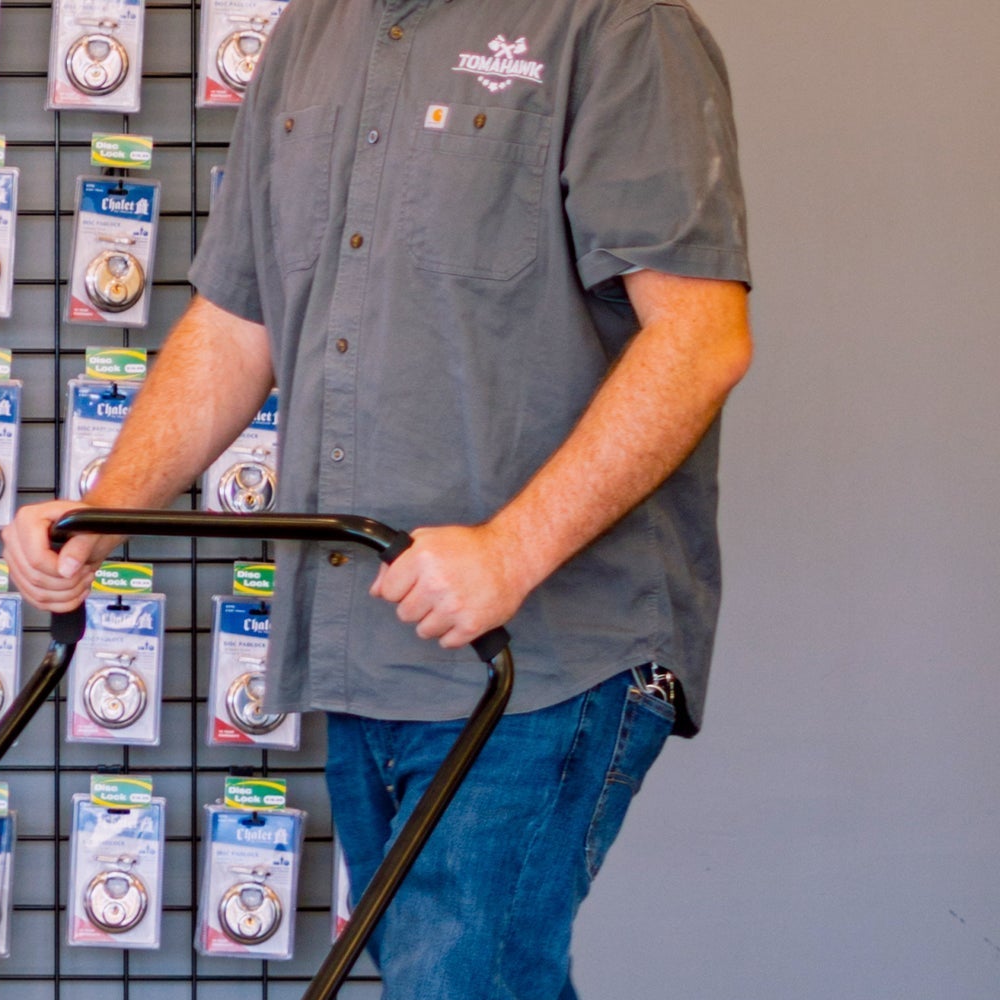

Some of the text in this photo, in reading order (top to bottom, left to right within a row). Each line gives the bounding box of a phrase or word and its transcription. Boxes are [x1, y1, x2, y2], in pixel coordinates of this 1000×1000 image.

[459, 53, 544, 79] TOMAHAWK
[96, 141, 119, 150] Disc
[100, 150, 125, 159] Lock
[101, 197, 134, 212] Chalet
[97, 402, 132, 416] Chale
[237, 571, 261, 579] Disc
[101, 578, 127, 586] Lock
[243, 579, 269, 587] Lock
[243, 619, 271, 632] Chal
[94, 784, 118, 792] Disc
[228, 786, 252, 794] Disc
[101, 793, 127, 801] Lock
[234, 795, 260, 803] Lock
[236, 828, 272, 842] Chalet
